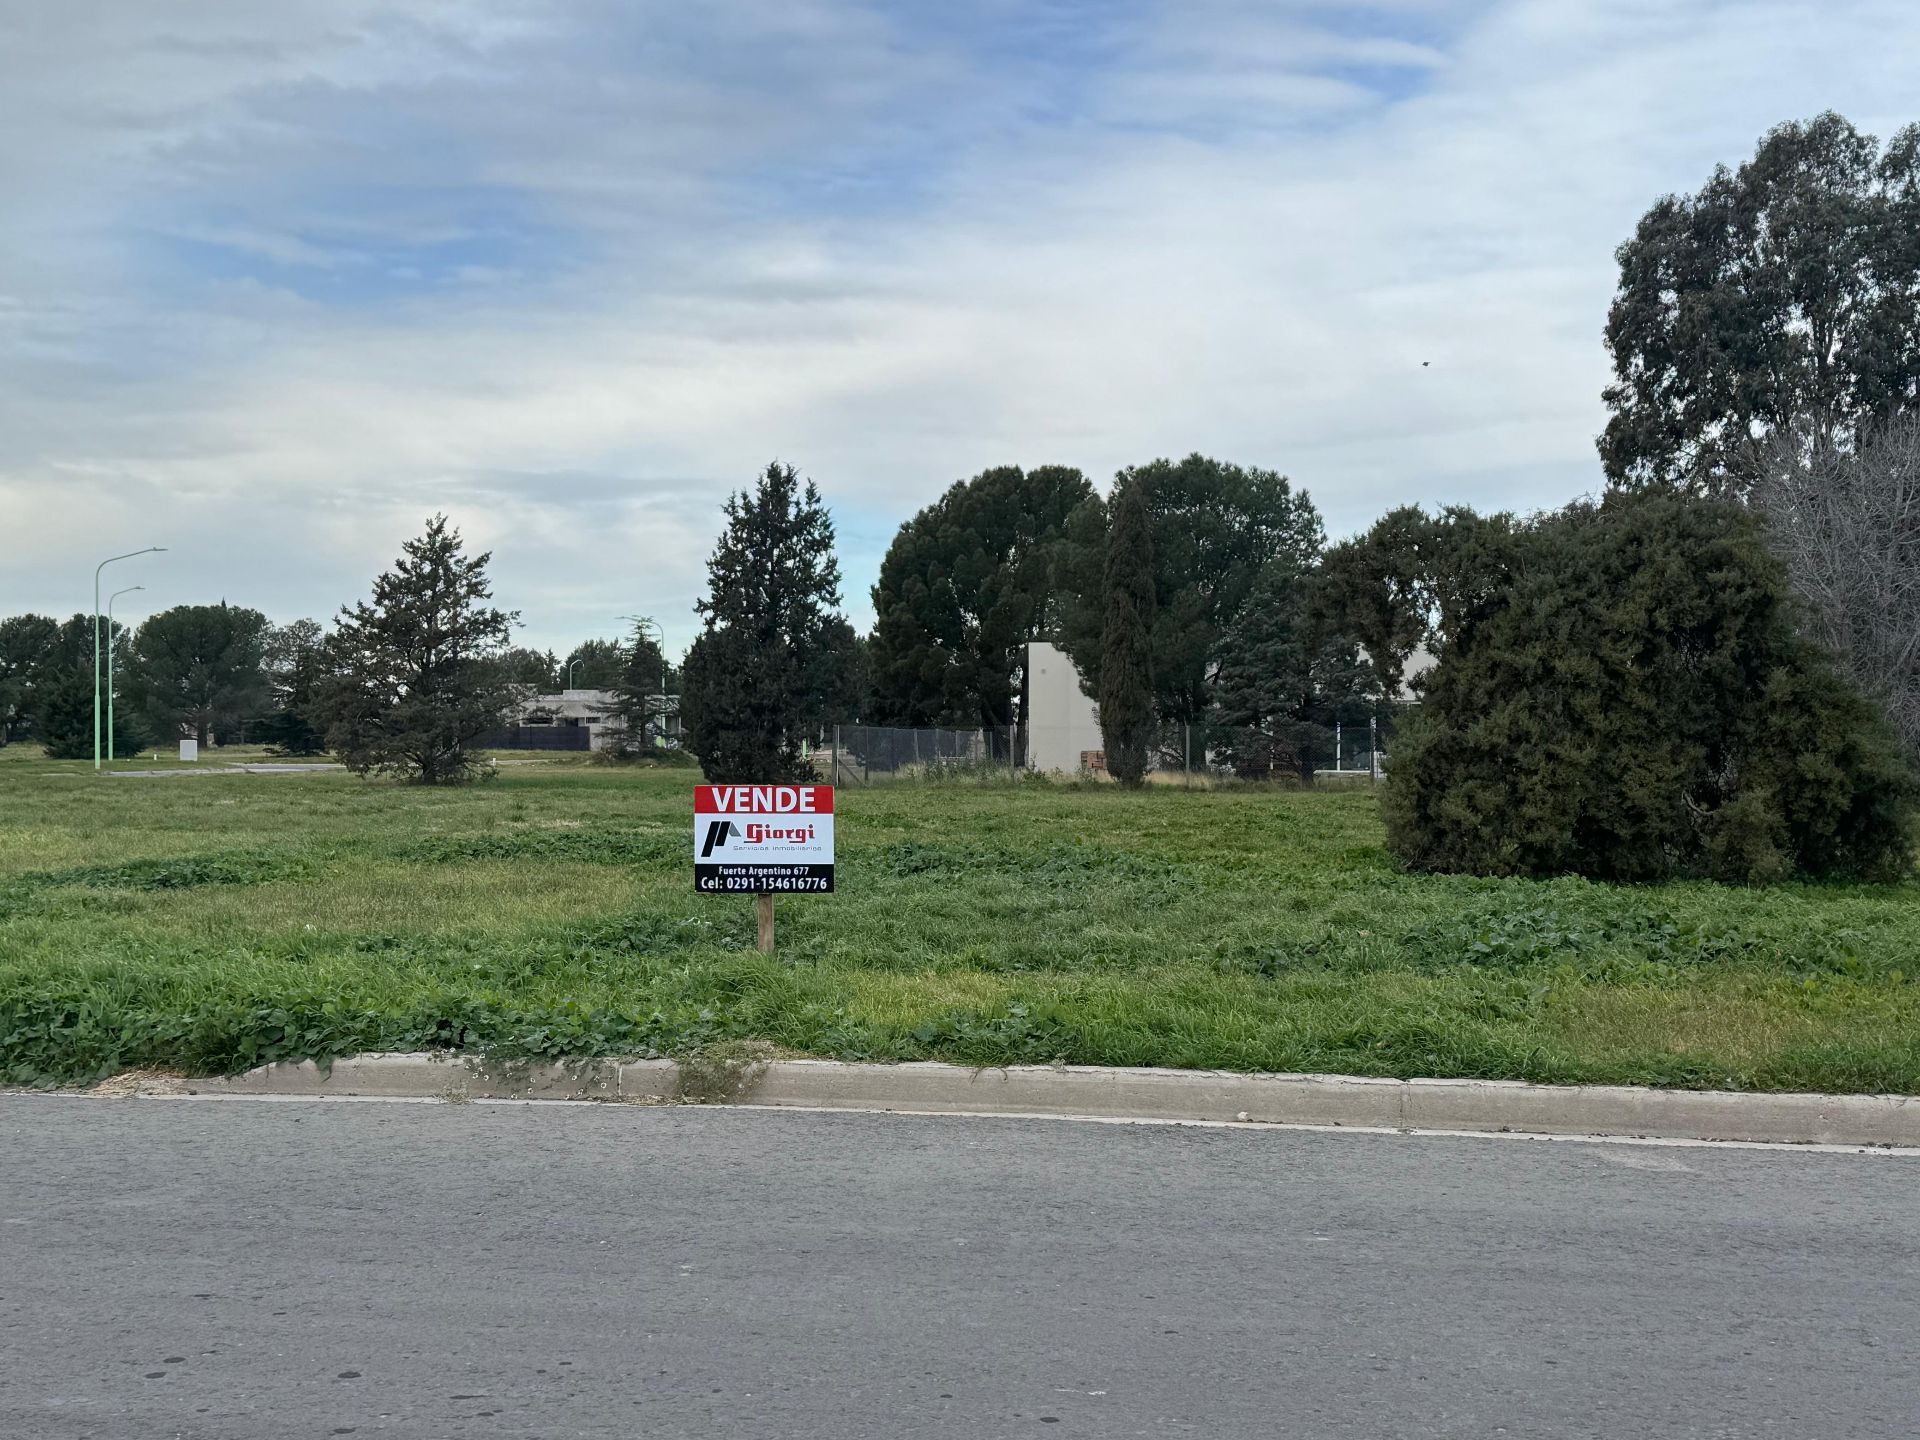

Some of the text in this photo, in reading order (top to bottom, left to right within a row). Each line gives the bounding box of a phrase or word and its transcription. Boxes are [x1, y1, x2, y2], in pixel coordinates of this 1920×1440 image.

[711, 787, 816, 812] VENDE
[743, 823, 815, 843] Giorgi
[718, 866, 809, 877] Fuerte Argentino 677
[701, 877, 827, 890] Cel: 0291-154616776
